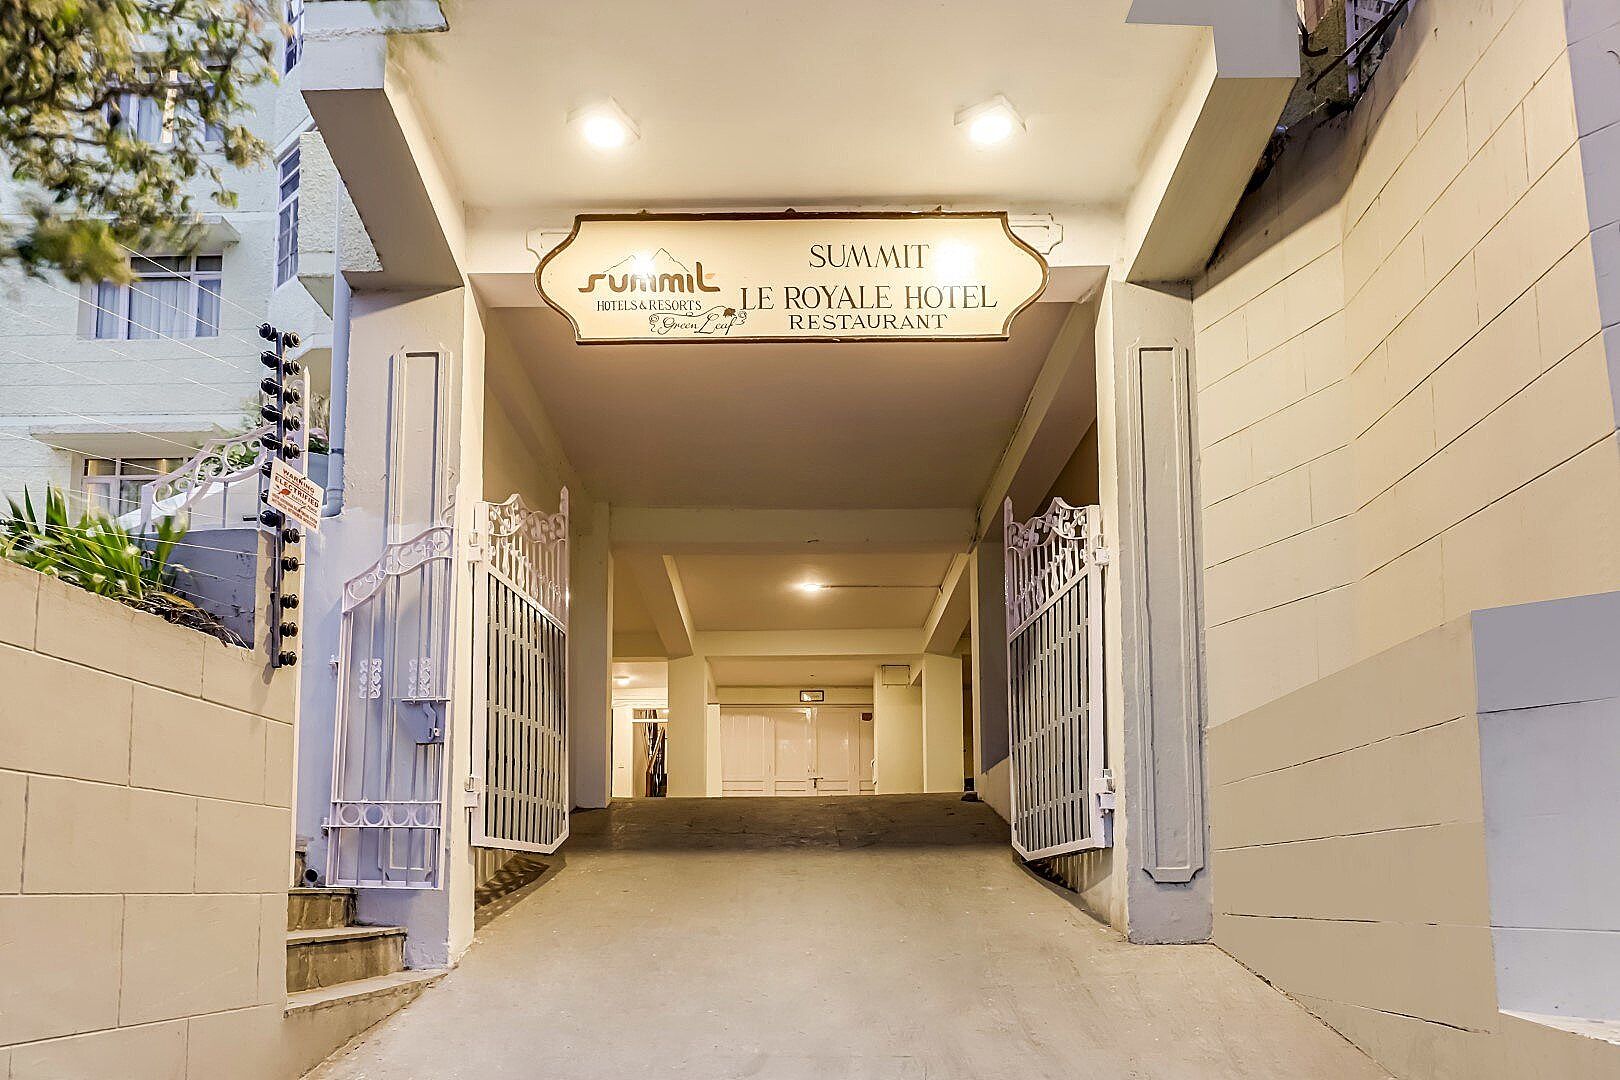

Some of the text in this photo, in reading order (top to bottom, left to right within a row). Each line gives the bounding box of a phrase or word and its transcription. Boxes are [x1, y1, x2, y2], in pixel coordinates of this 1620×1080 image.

[809, 244, 930, 269] SUMMIT
[597, 300, 638, 312] HOTELS
[649, 300, 702, 312] RESORTS
[740, 285, 998, 311] LE ROYALE HOTEL
[657, 313, 738, 335] Green Leaf
[788, 314, 949, 331] RESTAURANT
[274, 475, 319, 507] ELECTRIFIED
[283, 468, 315, 494] WARNING
